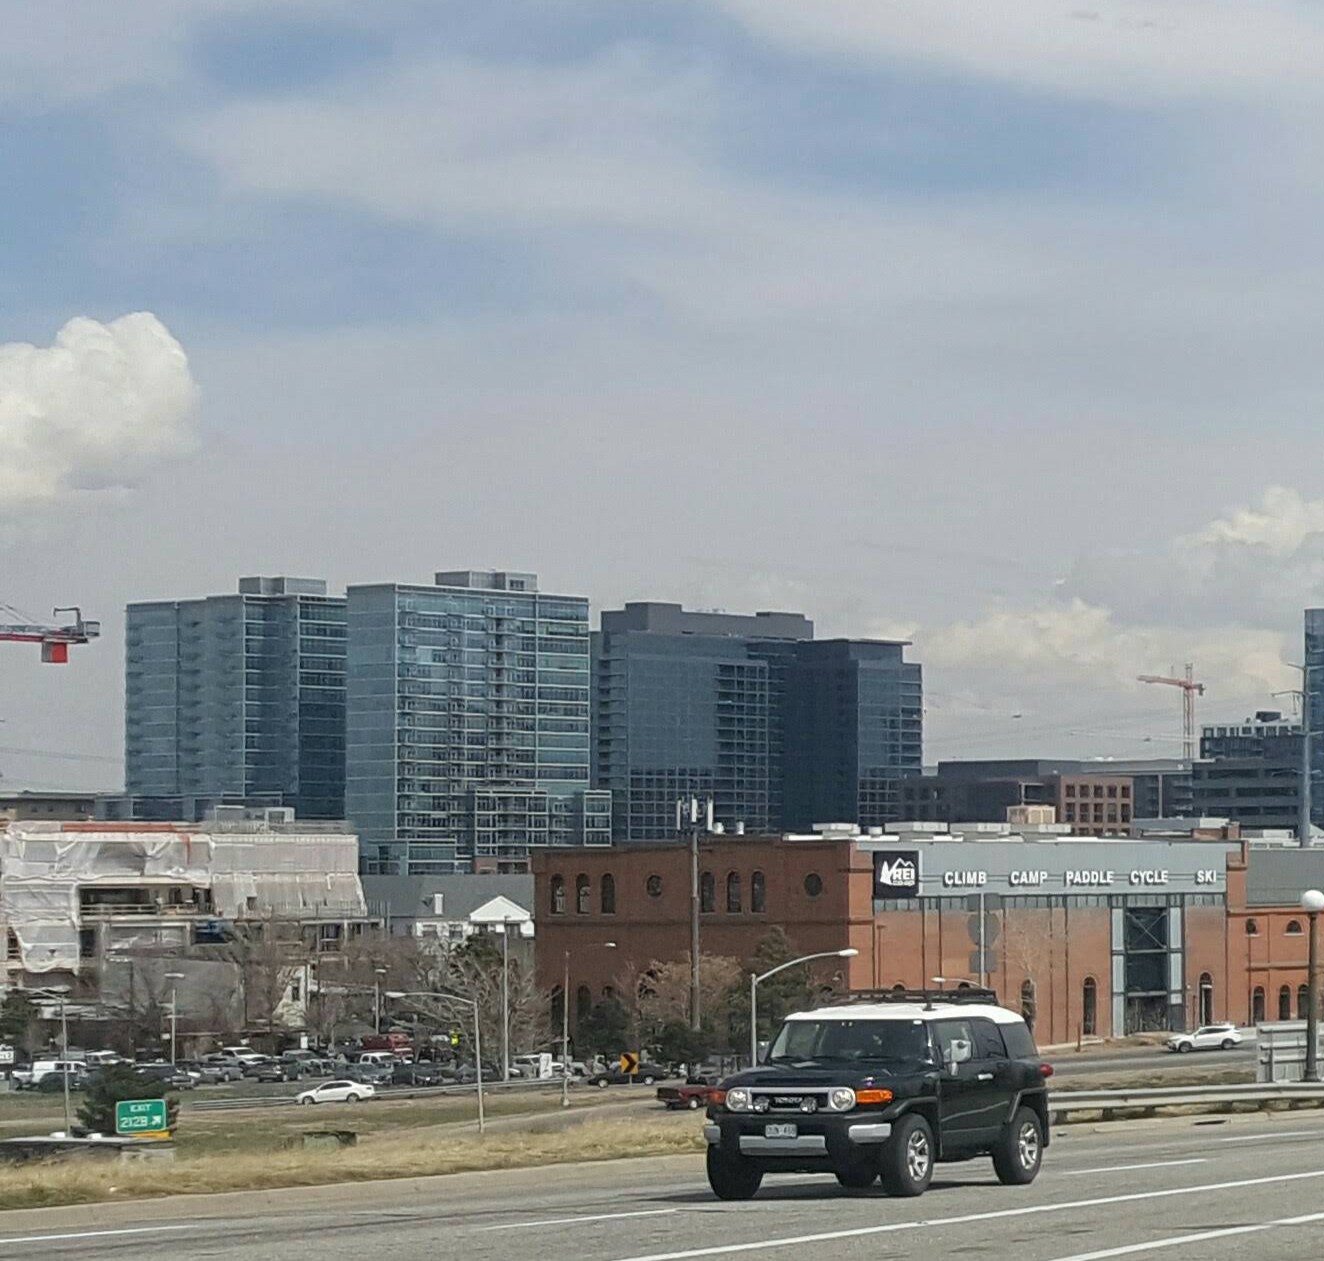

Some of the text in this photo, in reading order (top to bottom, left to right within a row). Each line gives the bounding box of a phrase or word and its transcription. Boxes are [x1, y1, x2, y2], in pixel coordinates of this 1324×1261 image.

[893, 867, 915, 880] REI
[944, 870, 1217, 885] CLIMB CAMP PADDLE CYCLE SKI
